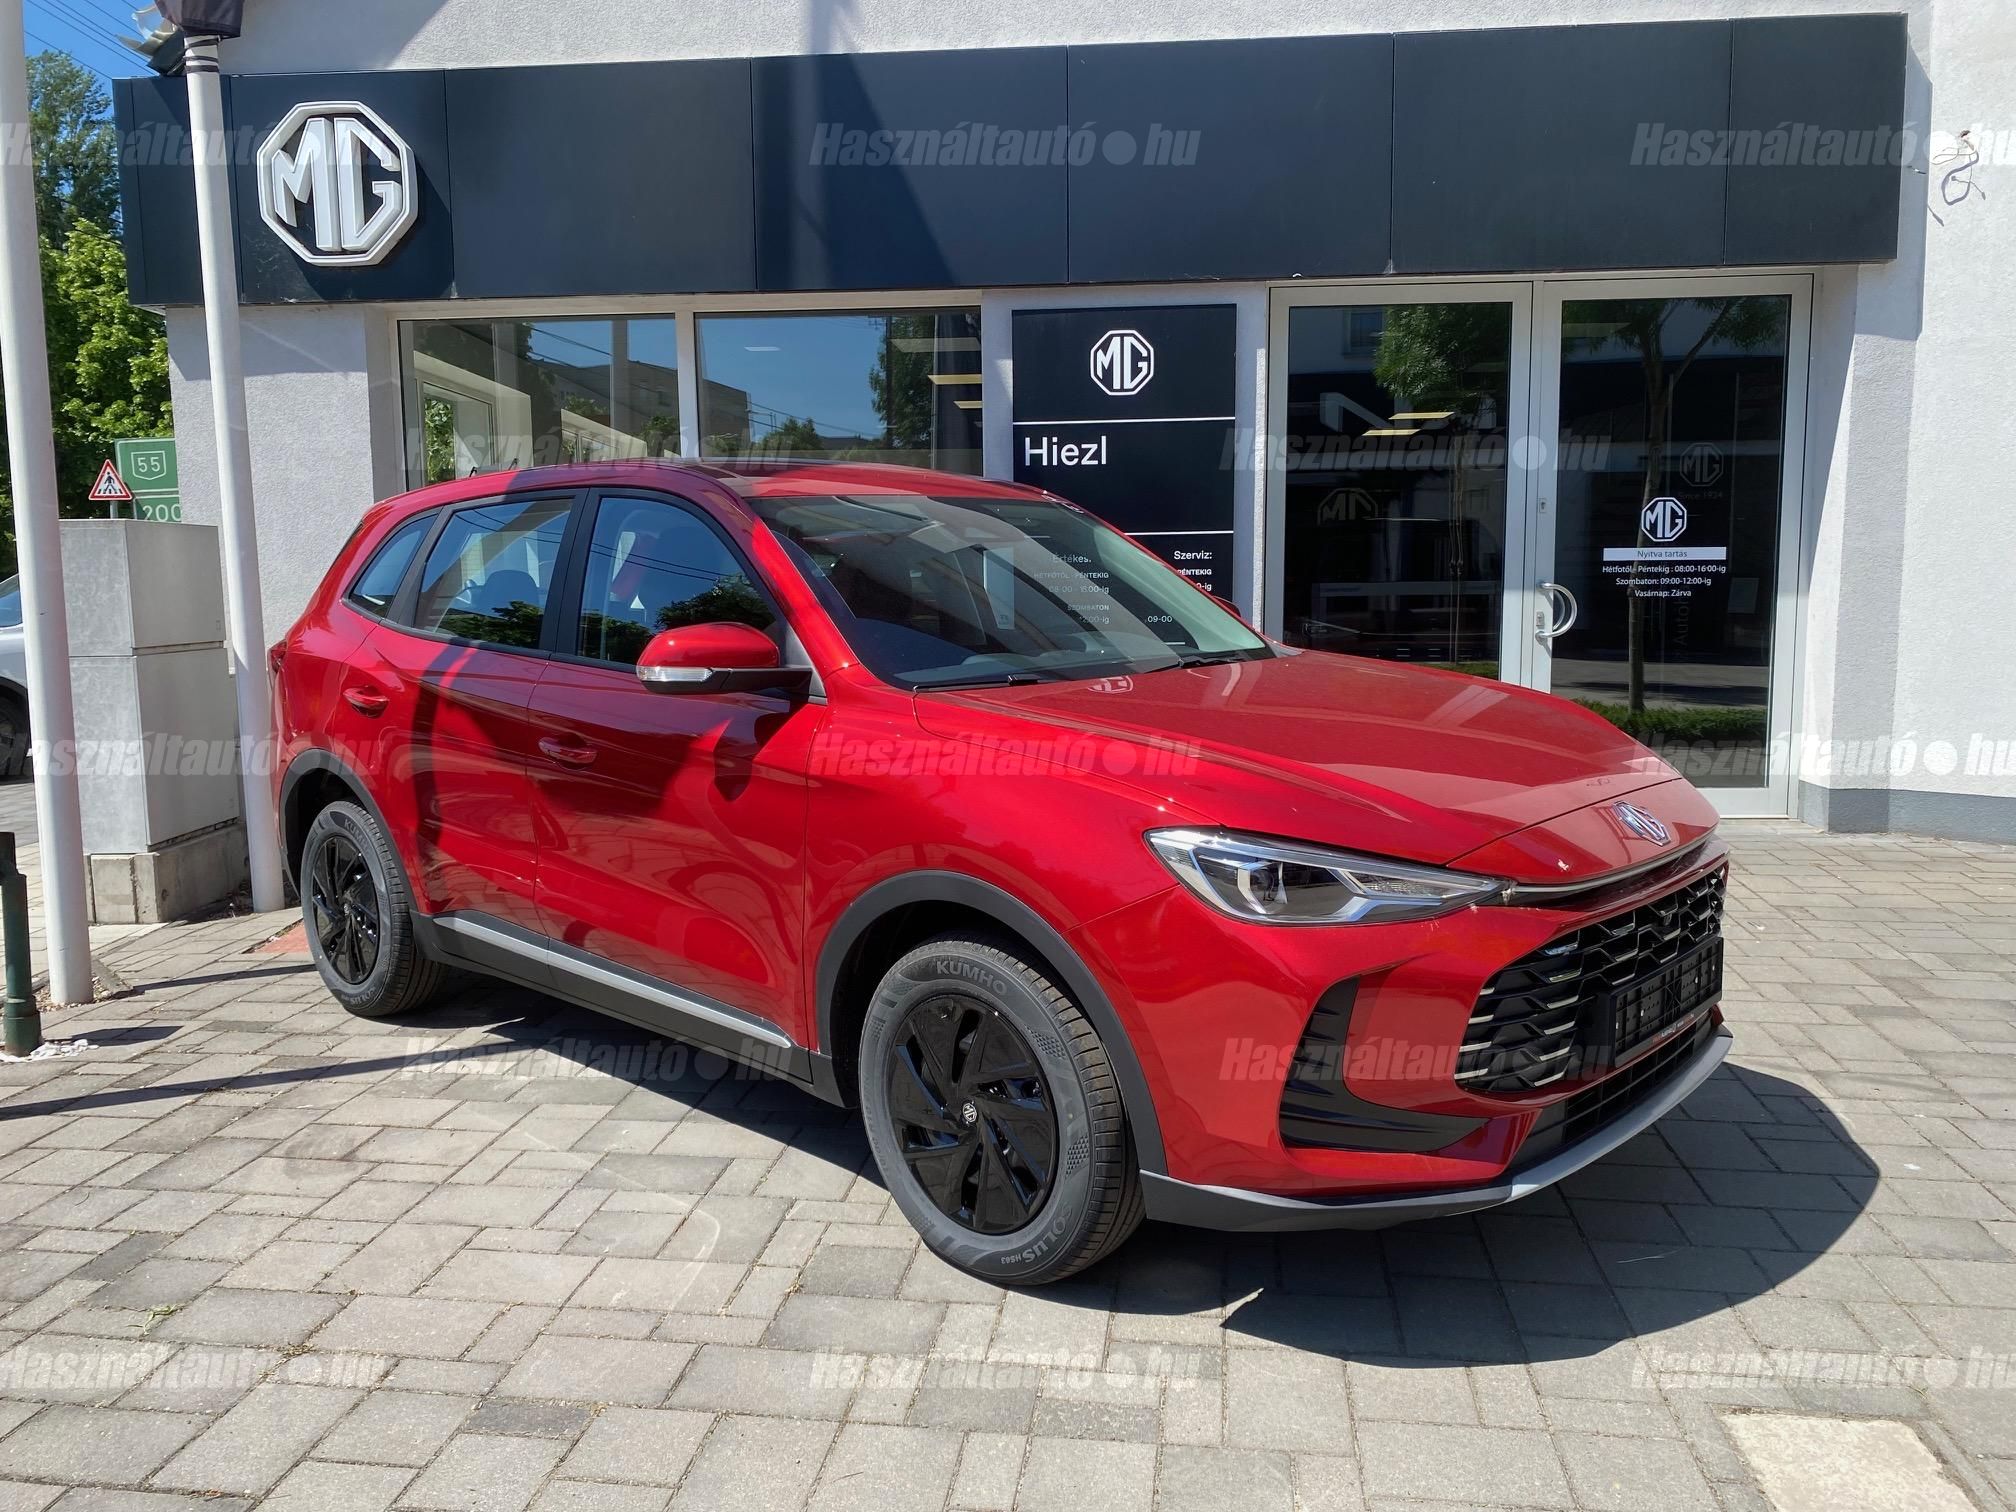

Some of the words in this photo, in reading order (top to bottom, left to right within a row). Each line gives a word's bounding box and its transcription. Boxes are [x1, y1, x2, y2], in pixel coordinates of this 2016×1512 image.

[269, 115, 405, 254] MG
[1095, 334, 1150, 391] MG
[137, 456, 161, 473] 55
[1024, 434, 1107, 467] Hiezl
[1683, 445, 1721, 483] MG
[1644, 500, 1684, 539] MG
[1173, 549, 1213, 560] Szerviz:
[1637, 550, 1662, 559] Nyitva
[1615, 577, 1659, 585] Szombaton:
[1671, 589, 1692, 597] Zárva
[936, 959, 1008, 998] KUMHO
